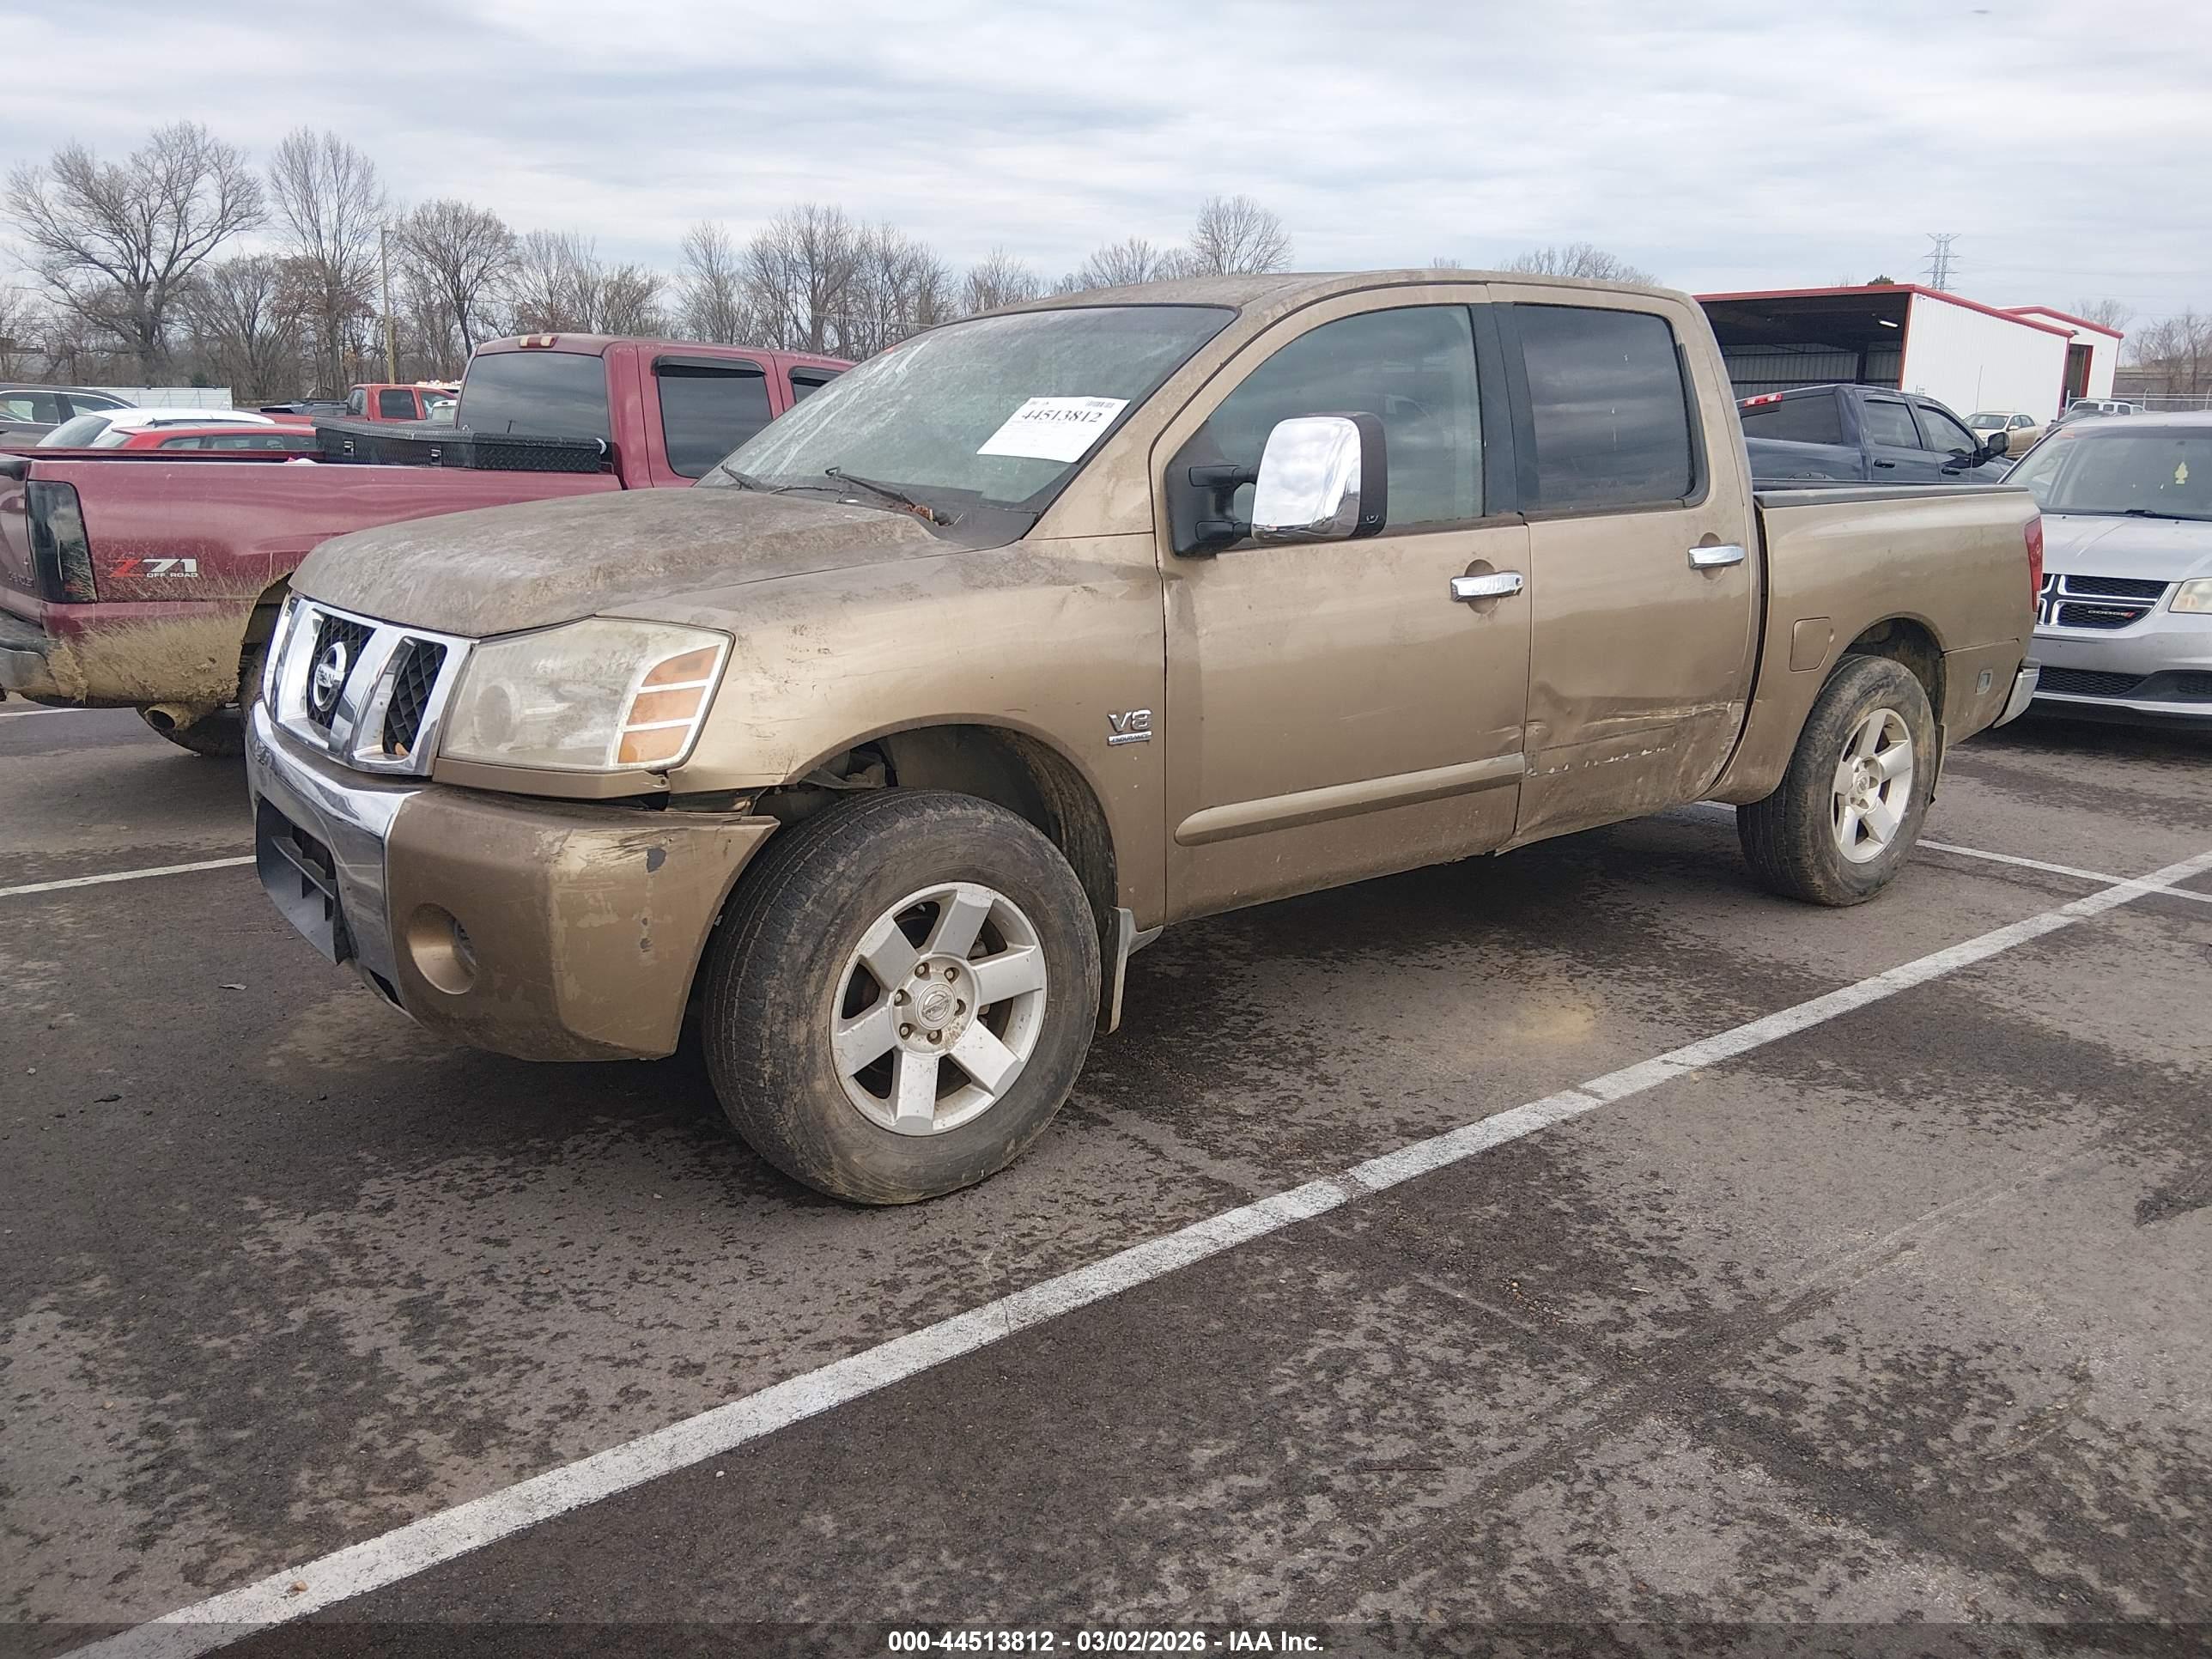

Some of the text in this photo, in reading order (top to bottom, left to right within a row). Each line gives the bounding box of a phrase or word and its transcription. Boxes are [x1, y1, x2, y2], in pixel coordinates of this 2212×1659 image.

[1022, 410, 1103, 422] 44513812
[109, 558, 198, 578] Z71
[1108, 709, 1152, 732] V8
